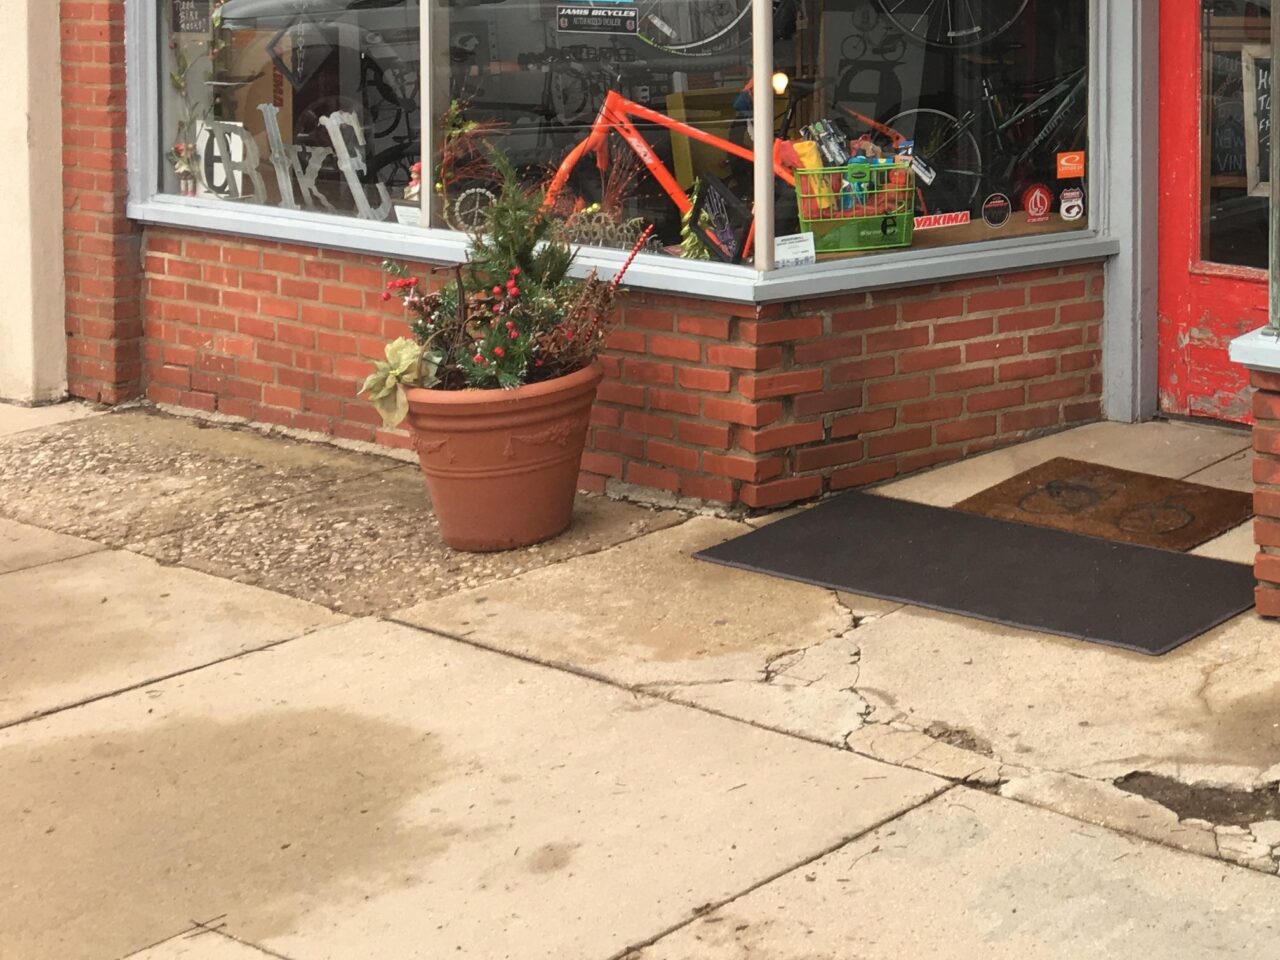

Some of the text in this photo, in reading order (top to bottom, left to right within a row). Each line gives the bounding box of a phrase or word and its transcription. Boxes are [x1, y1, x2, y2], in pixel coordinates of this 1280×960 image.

[591, 9, 636, 17] BICYCLES
[201, 102, 393, 222] BIKE
[915, 213, 969, 228] YAKIMA
